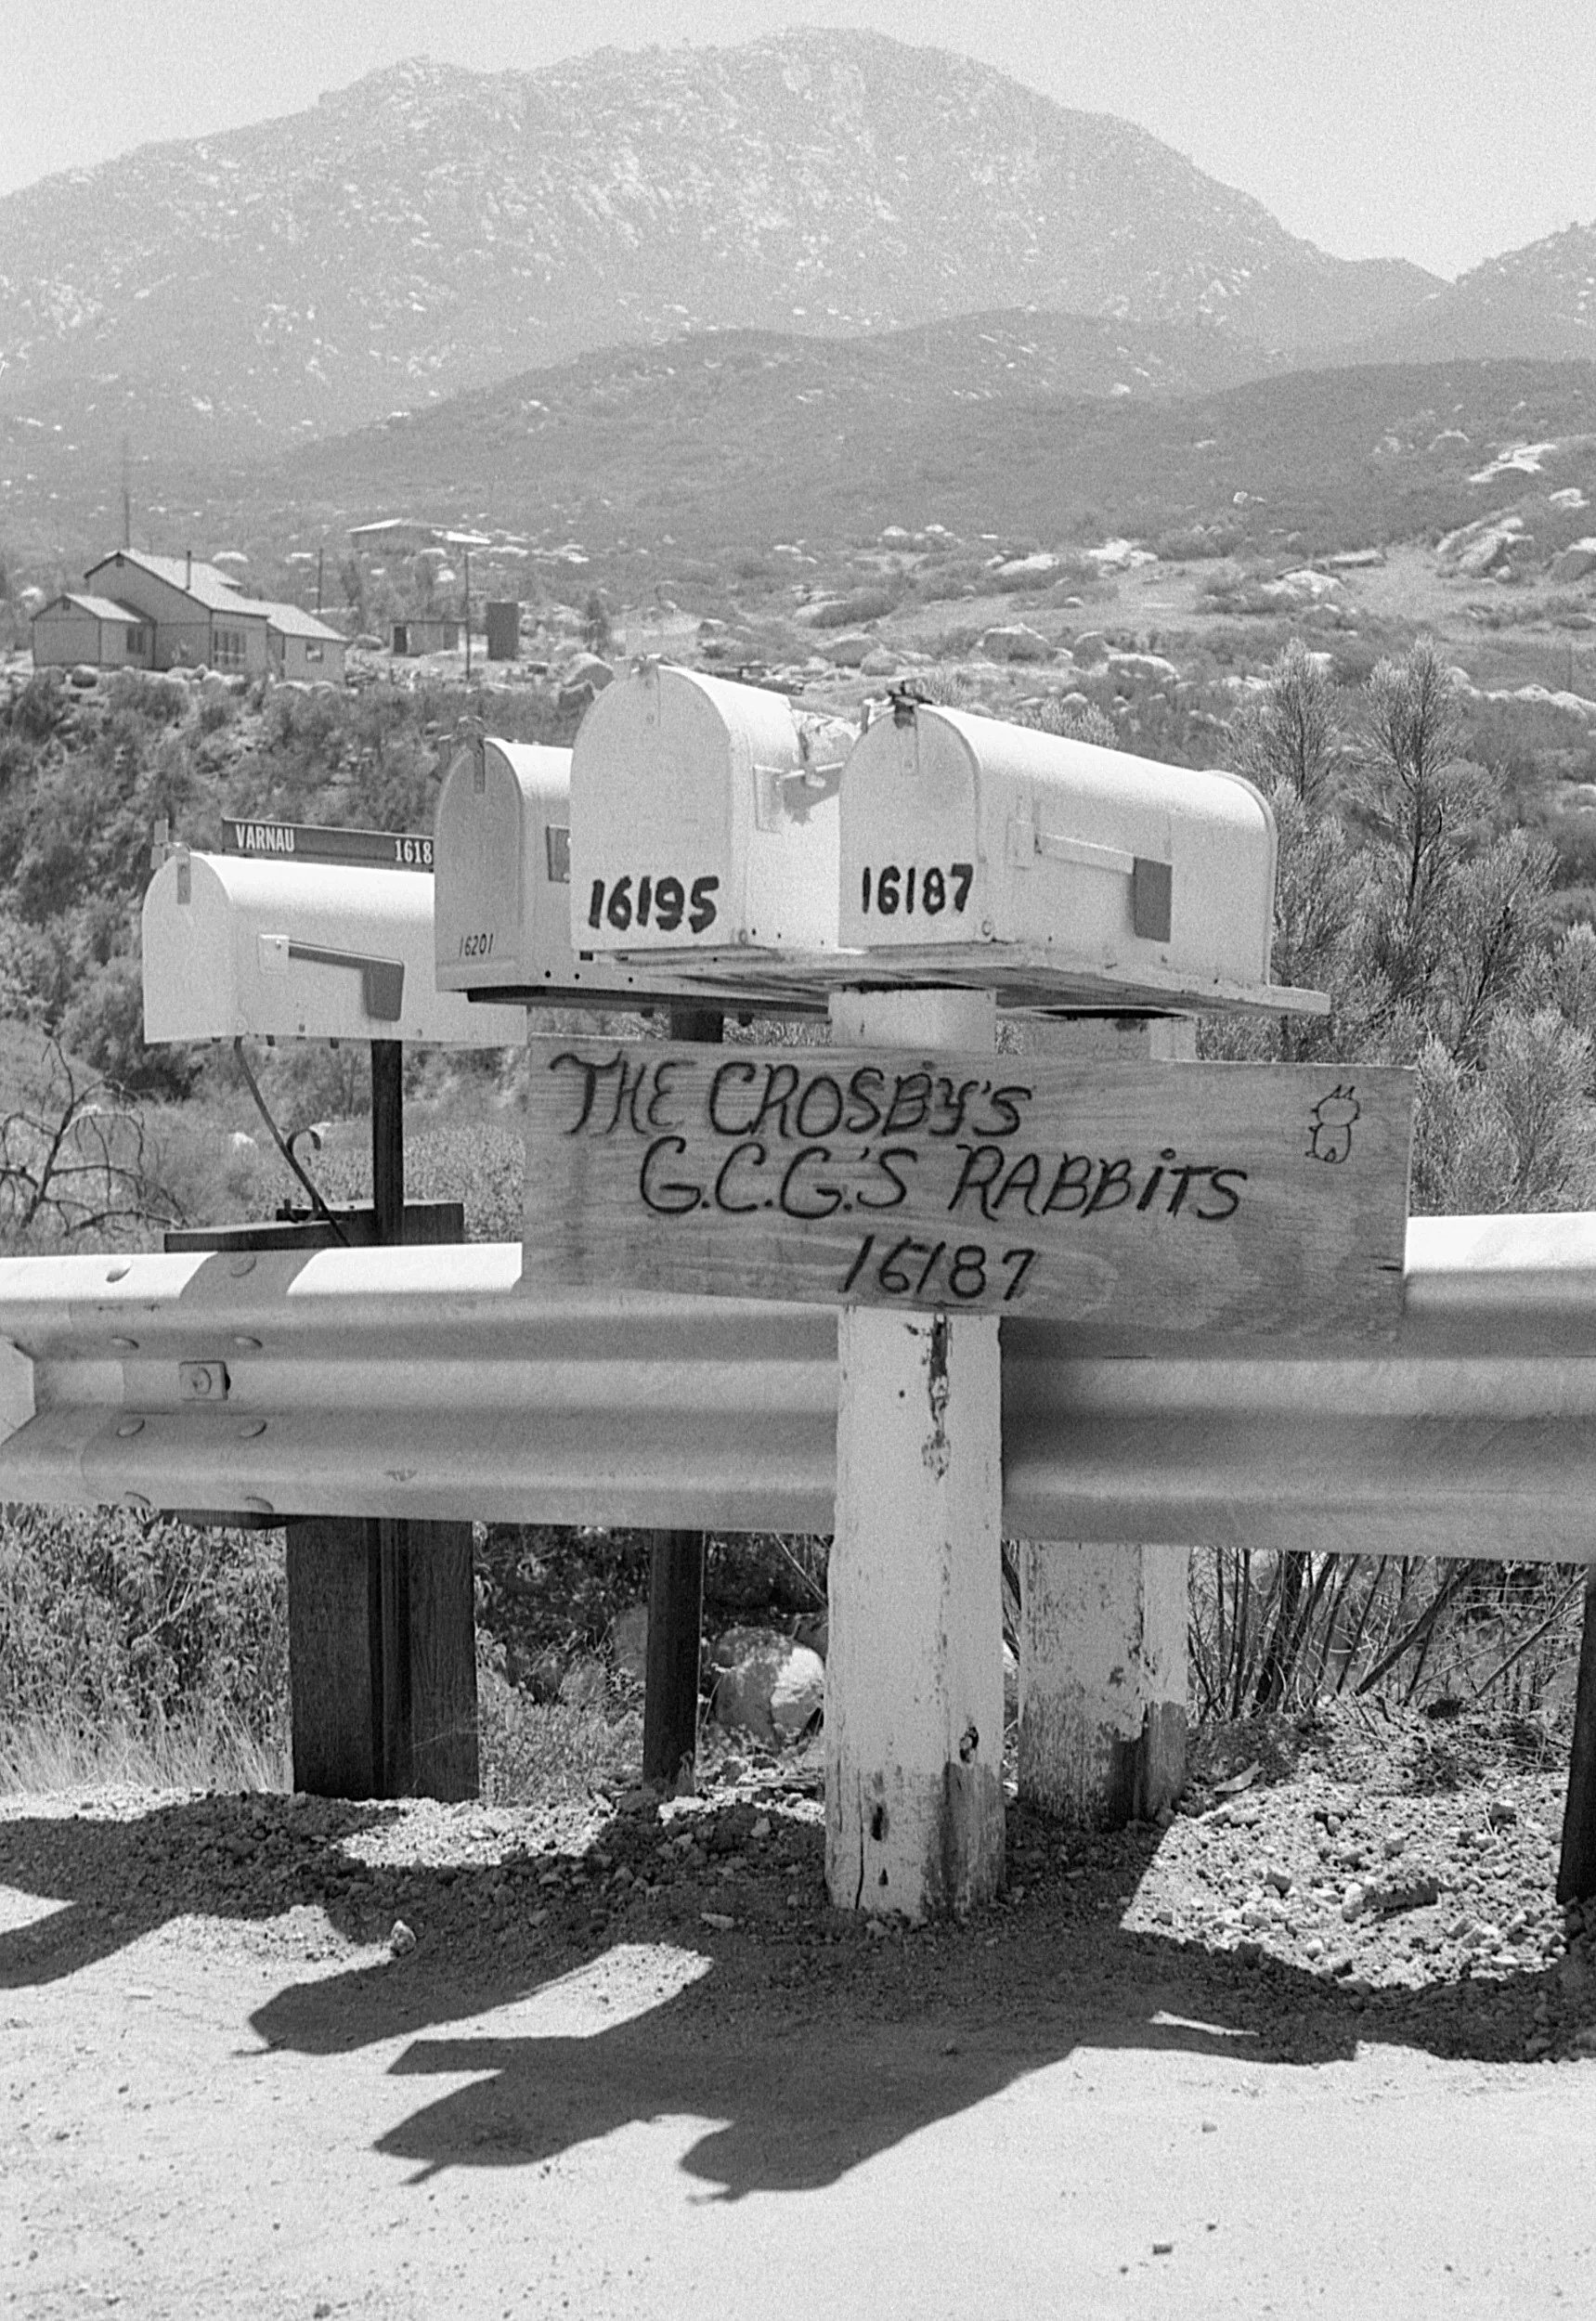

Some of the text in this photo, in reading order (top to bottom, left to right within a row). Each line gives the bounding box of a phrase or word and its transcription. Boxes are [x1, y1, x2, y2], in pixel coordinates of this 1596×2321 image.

[235, 823, 294, 853] VARNAU
[588, 875, 720, 934] 16195
[862, 863, 974, 915] 16187
[459, 933, 493, 958] 16201
[550, 1050, 1032, 1138] THE CROSBY'S
[844, 1235, 1038, 1301] 16187
